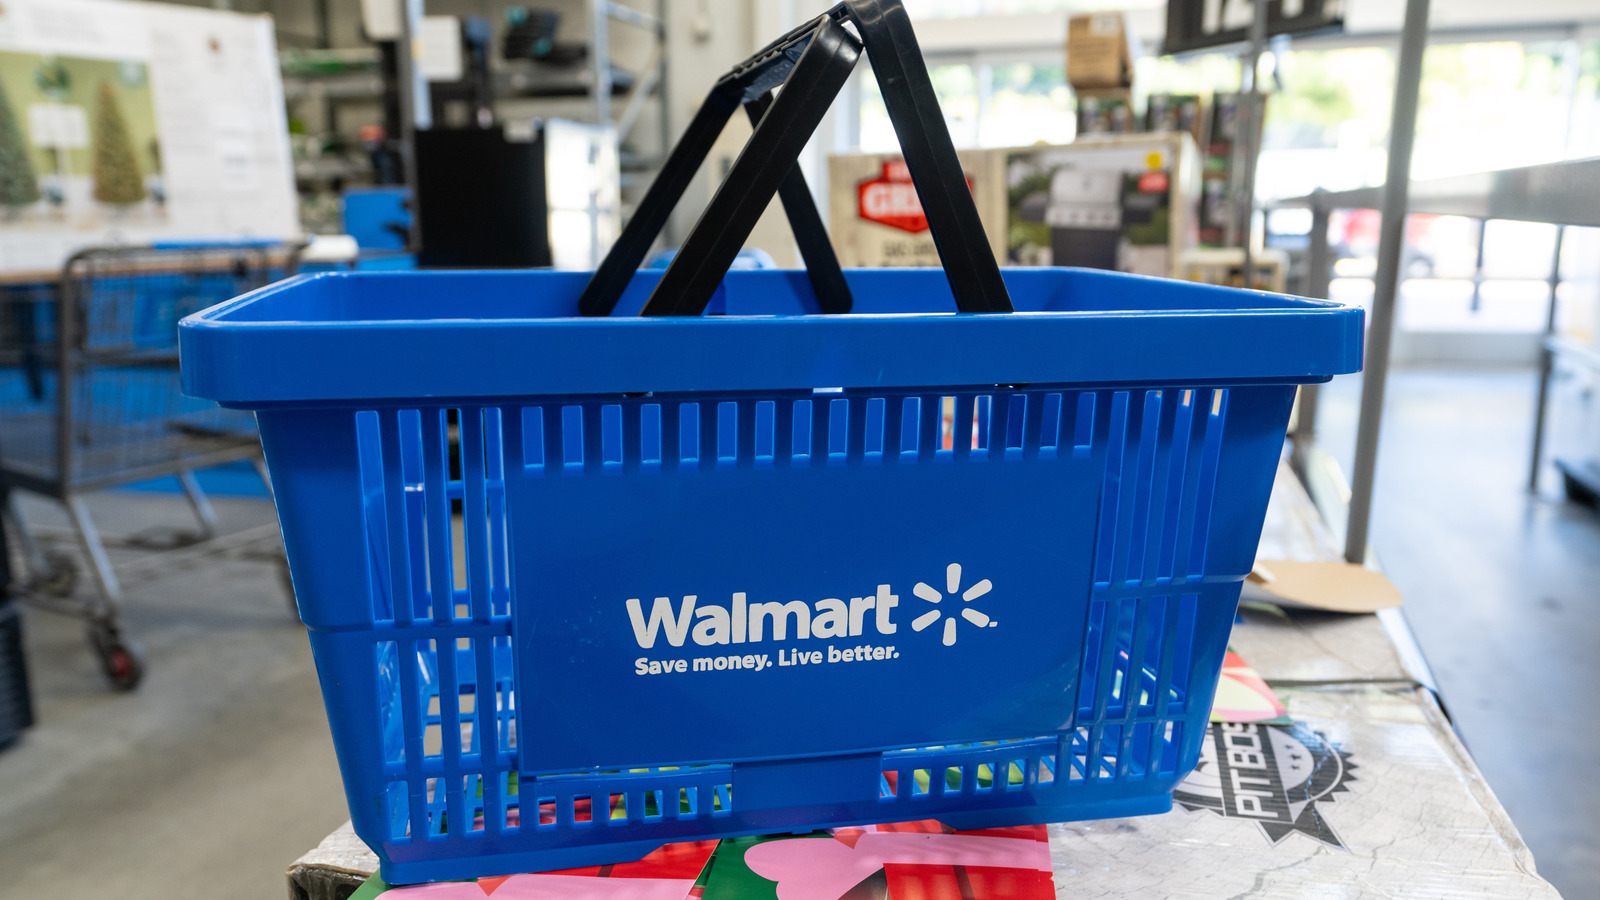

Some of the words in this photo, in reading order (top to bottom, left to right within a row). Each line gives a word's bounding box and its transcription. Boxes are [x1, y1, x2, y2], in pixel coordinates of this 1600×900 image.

[626, 584, 899, 649] Walmart
[635, 657, 688, 676] Save
[693, 654, 773, 673] money.
[778, 648, 824, 667] Live
[828, 644, 900, 663] better.
